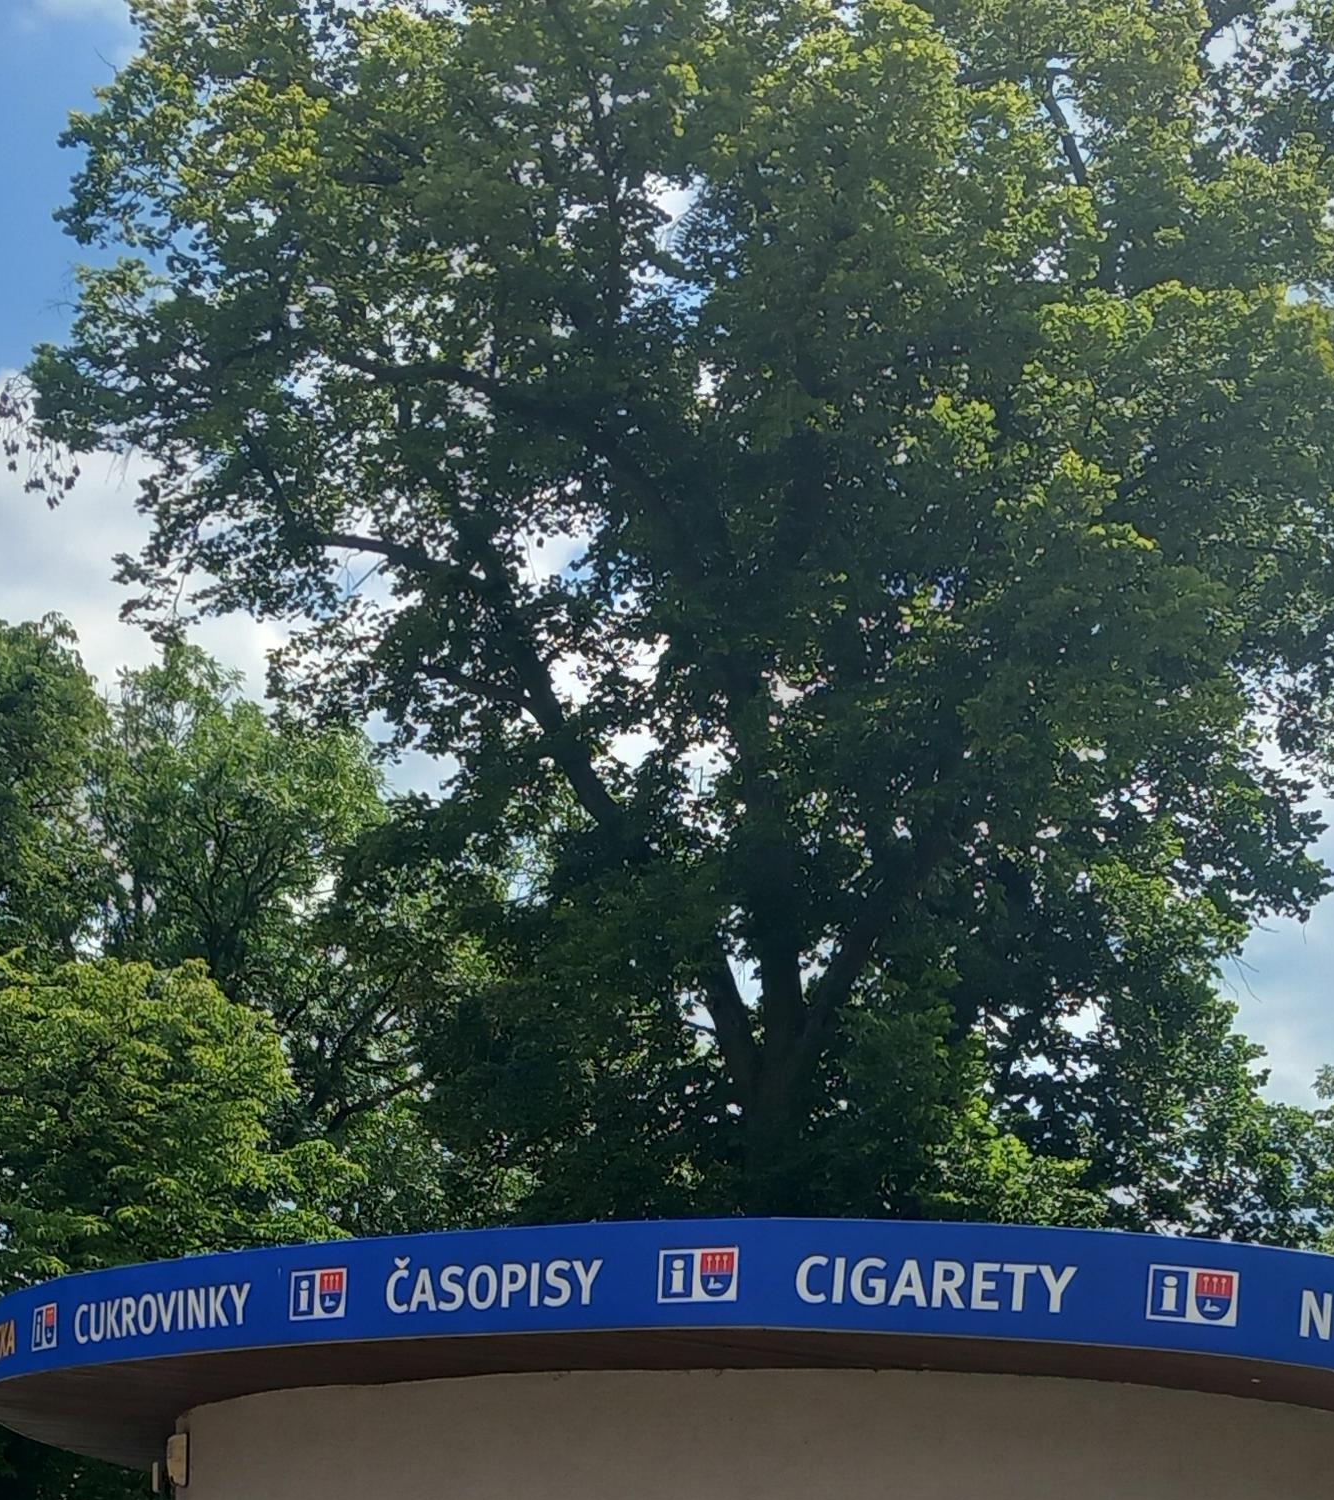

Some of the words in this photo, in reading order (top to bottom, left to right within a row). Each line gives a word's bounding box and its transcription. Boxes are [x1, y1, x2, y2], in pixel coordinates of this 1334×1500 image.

[74, 1282, 251, 1345] CUKROVINKY
[385, 1256, 604, 1315] ČASOPISY
[795, 1255, 1079, 1314] CIGARETY
